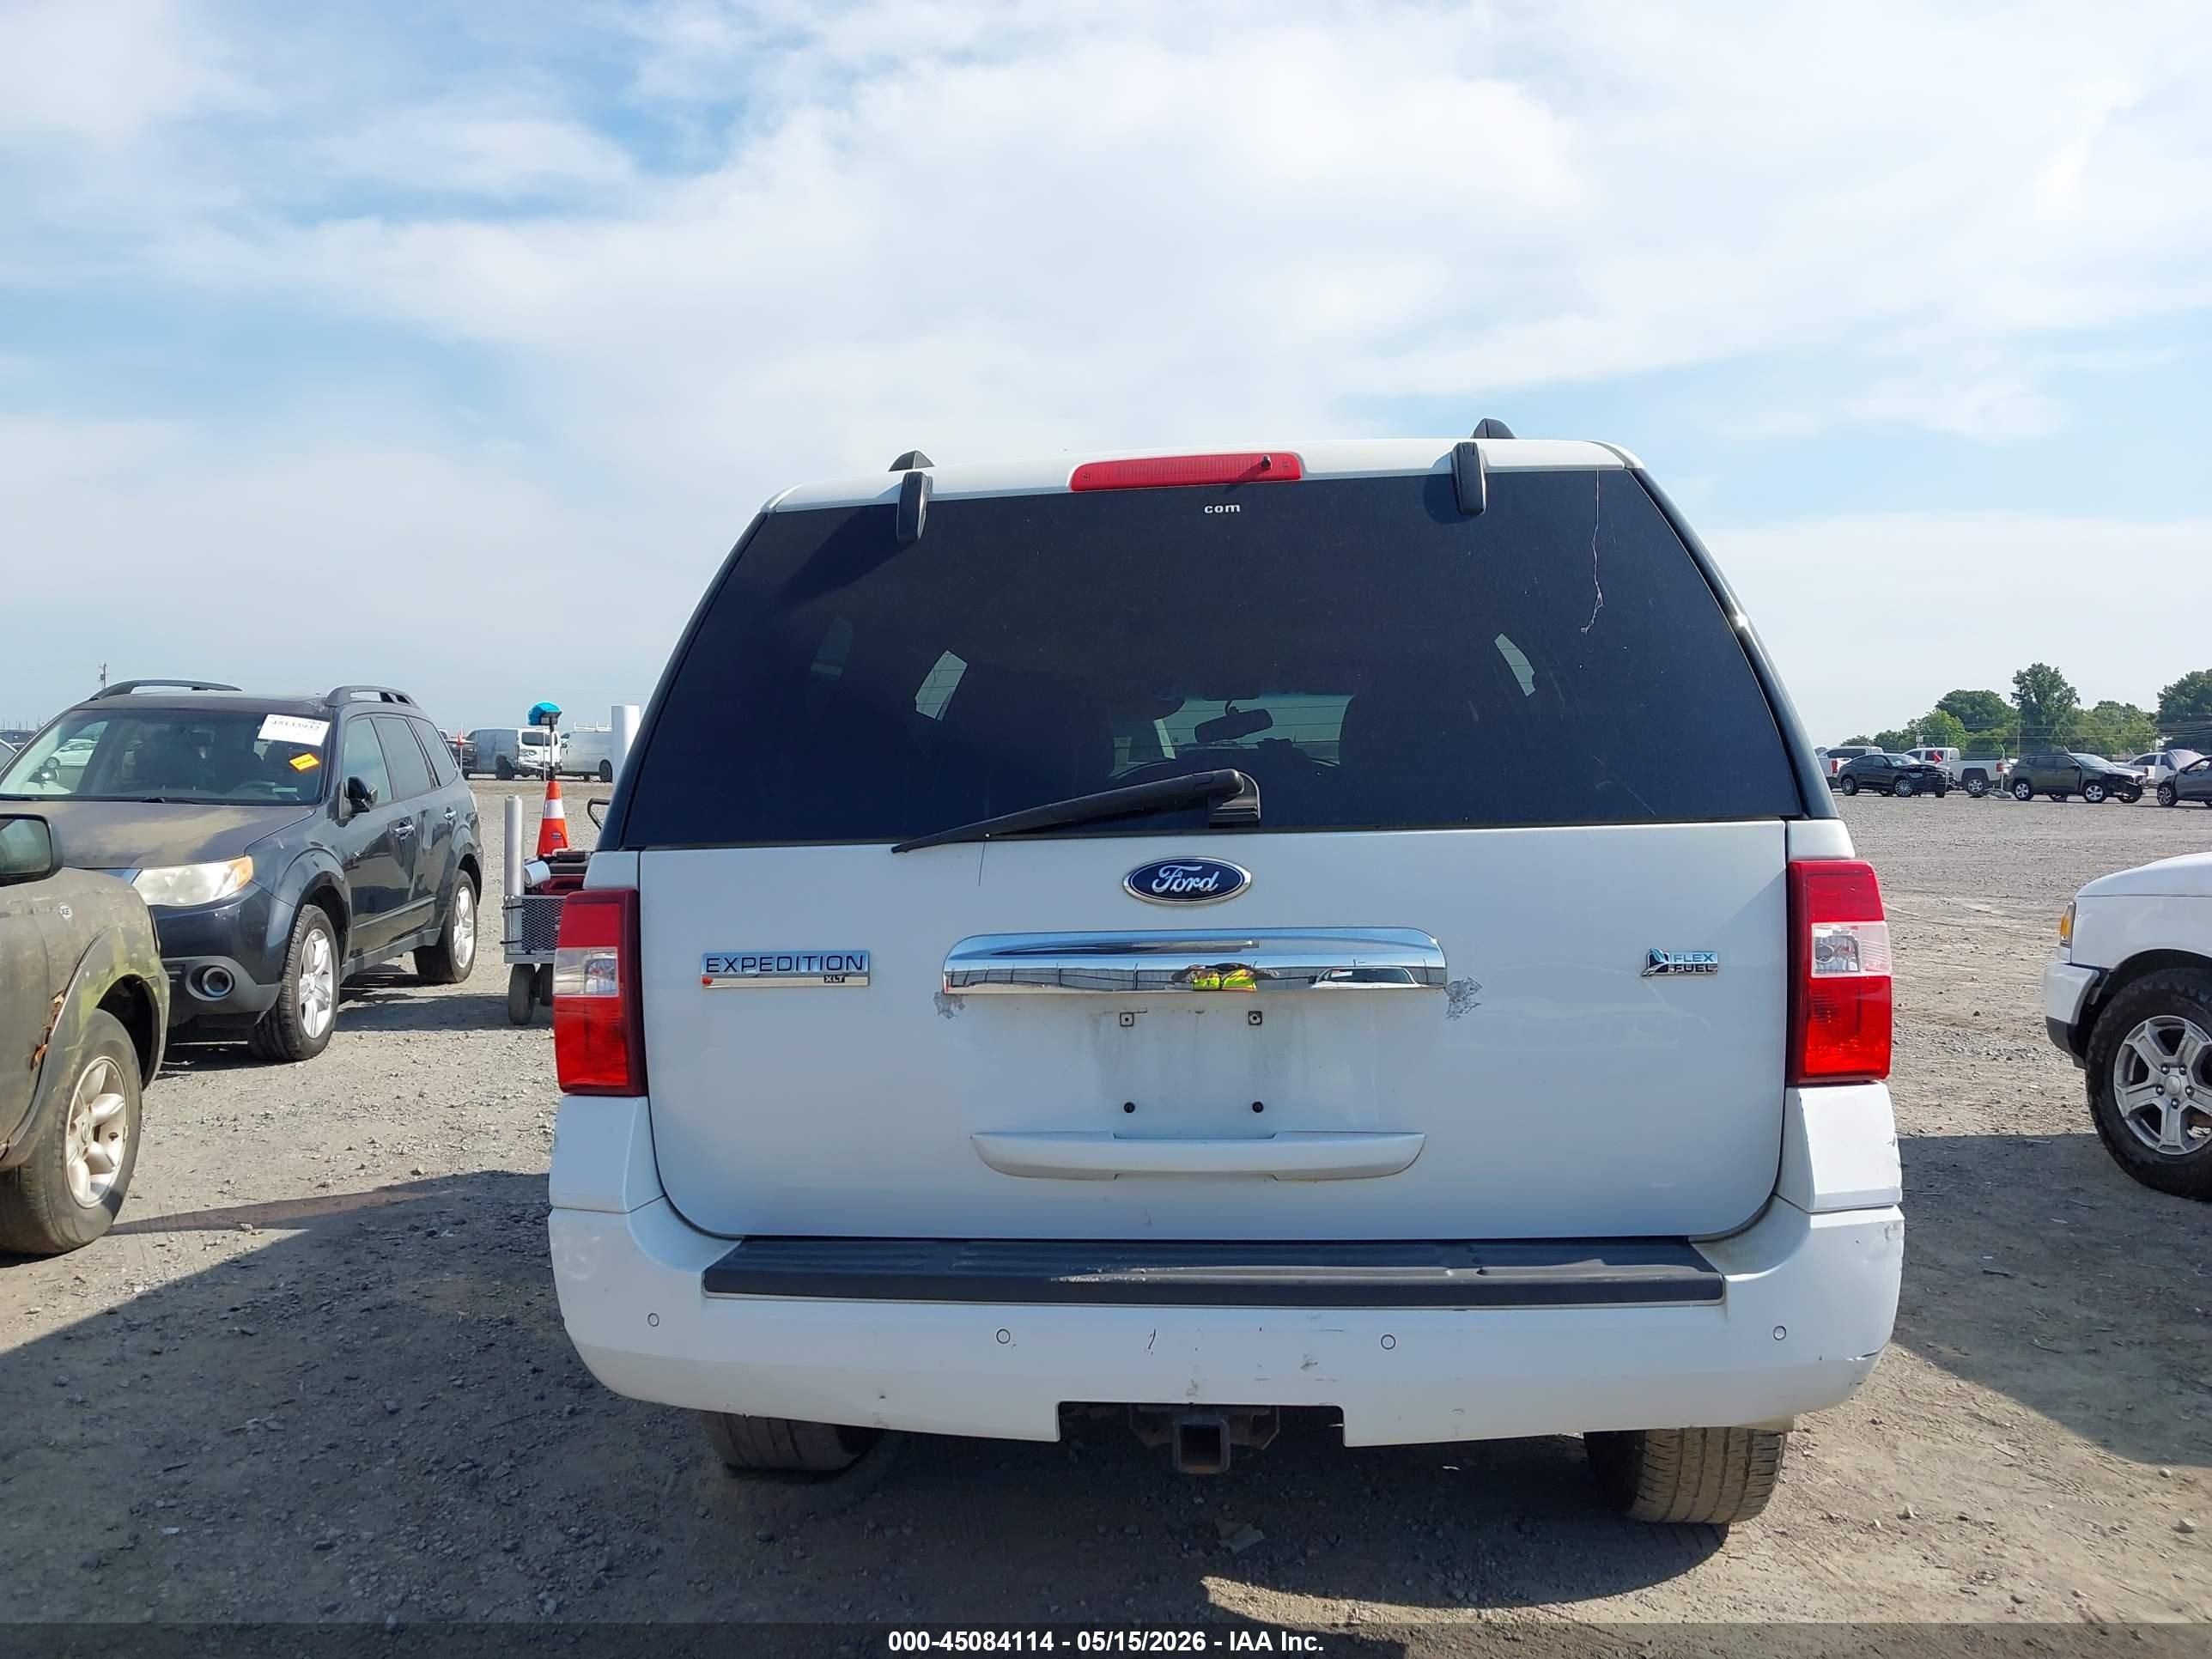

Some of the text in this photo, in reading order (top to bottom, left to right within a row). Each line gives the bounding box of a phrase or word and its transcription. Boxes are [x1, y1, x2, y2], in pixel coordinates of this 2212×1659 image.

[1204, 503, 1241, 514] com
[1152, 865, 1220, 893] Ford
[1674, 953, 1714, 963] FLEX
[706, 955, 864, 973] EXPEDITION
[1674, 963, 1715, 973] FUEL
[824, 975, 845, 983] XLT
